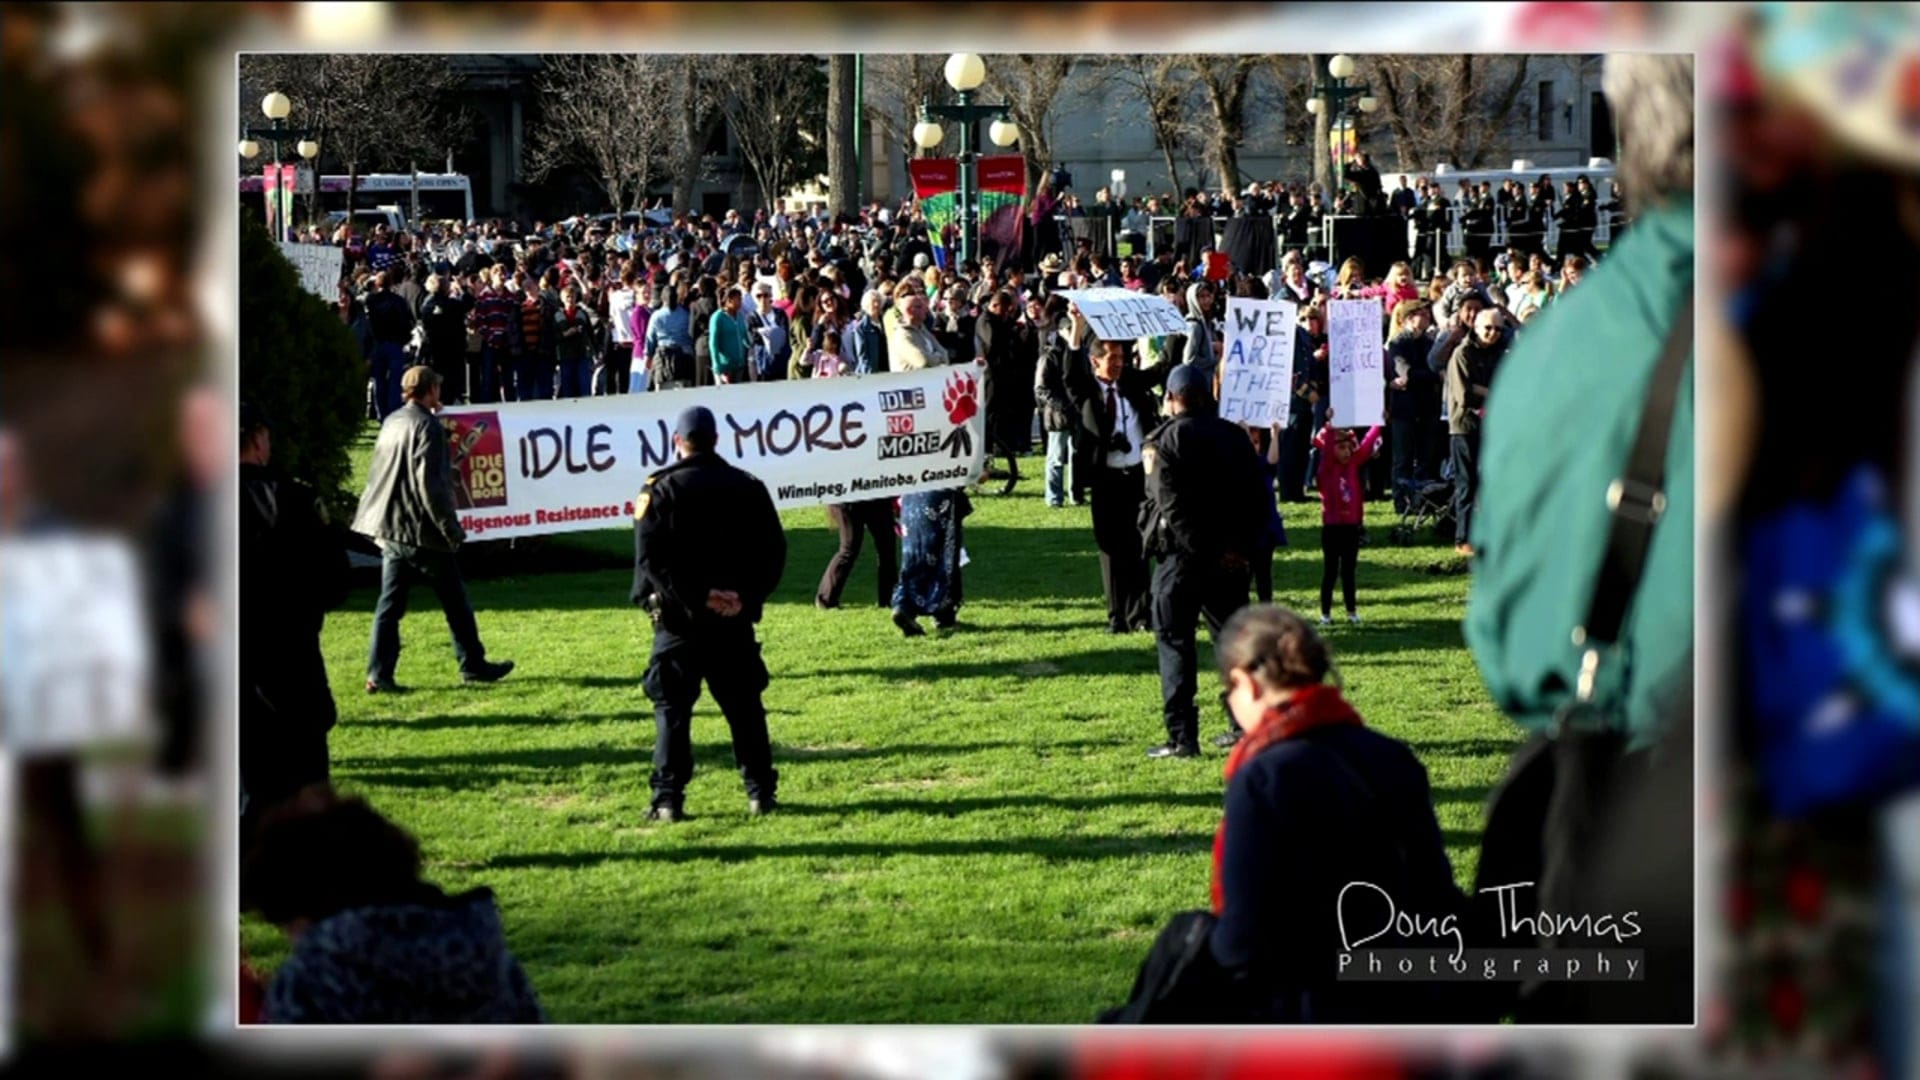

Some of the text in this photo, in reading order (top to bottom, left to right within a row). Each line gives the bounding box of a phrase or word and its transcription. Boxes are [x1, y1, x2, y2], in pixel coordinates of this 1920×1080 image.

[1090, 307, 1187, 338] TREATIES
[1233, 307, 1286, 336] WE
[1227, 335, 1287, 368] ARE
[1228, 369, 1281, 393] THE
[878, 388, 925, 412] IDLE
[1223, 397, 1289, 421] FUTURE
[887, 414, 914, 434] NO
[519, 425, 616, 480] IDLE
[638, 419, 676, 467] N
[725, 402, 867, 457] MORE
[878, 432, 940, 459] MORE
[469, 453, 503, 469] IDLE
[777, 464, 969, 501] Winnipeg, Manitoba, Canada
[460, 500, 635, 533] digenous Resistance &
